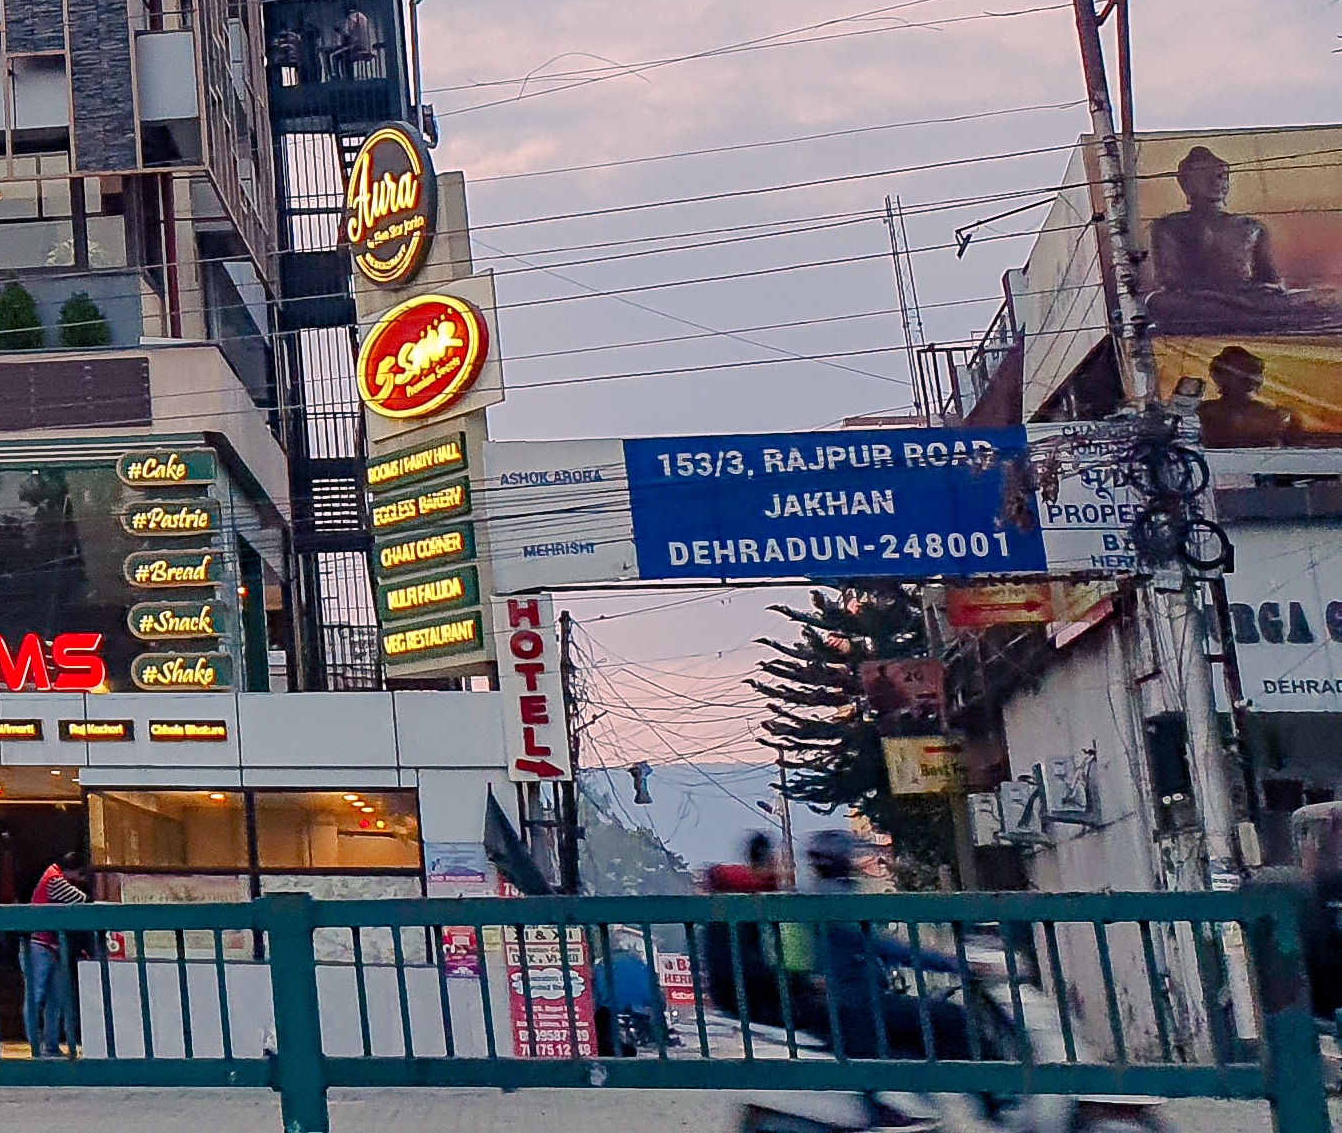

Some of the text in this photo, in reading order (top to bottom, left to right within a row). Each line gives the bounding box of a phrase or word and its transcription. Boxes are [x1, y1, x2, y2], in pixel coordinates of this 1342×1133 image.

[348, 152, 418, 242] Aura
[127, 453, 186, 480] #Cake
[367, 465, 399, 484] ROOMS
[404, 451, 434, 474] PARTY
[434, 442, 461, 465] HALL
[500, 468, 603, 486] ASHOK ARORA
[658, 440, 994, 480] 153/3, RAJPUR ROAD
[373, 485, 462, 527] EGGLESS BAKERY
[765, 489, 895, 519] JAKHAN
[380, 532, 462, 567] CHAAT CORNER
[669, 532, 1010, 566] DEHRADUN-248001
[135, 555, 212, 582] #Bread
[387, 585, 417, 610] KULFI
[139, 605, 213, 633] #Snack
[384, 620, 474, 654] VEG RESTAURANT
[142, 657, 214, 685] #Shake
[508, 598, 551, 757] HOTEL
